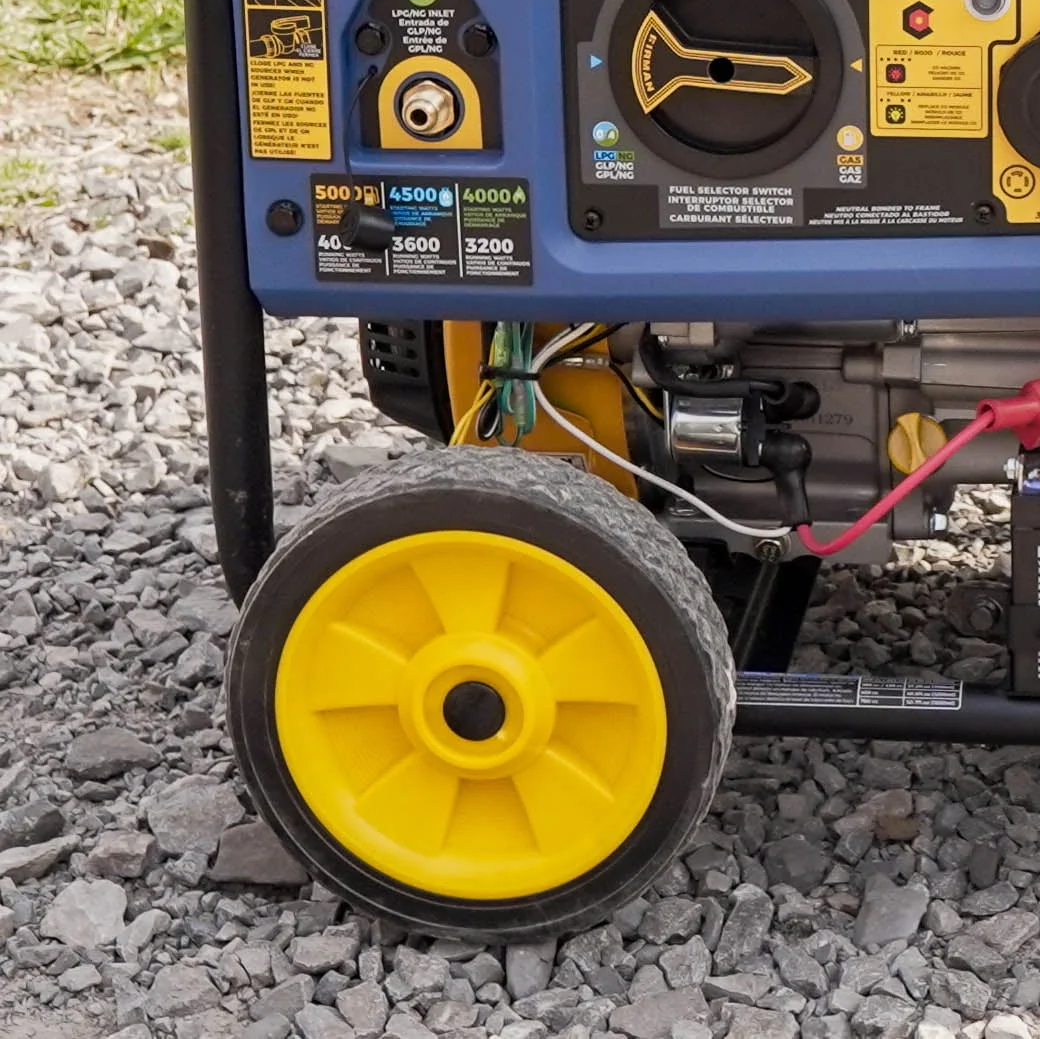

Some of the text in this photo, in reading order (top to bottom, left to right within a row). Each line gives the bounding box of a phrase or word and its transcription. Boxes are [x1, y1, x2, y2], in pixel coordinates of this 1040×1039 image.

[391, 10, 455, 18] LPG/NG INLET
[399, 19, 435, 27] Entrada
[407, 28, 442, 36] GLP/NG
[402, 36, 434, 44] Entrée
[408, 45, 443, 53] GPL/NG
[642, 34, 657, 92] FIRMAN
[619, 152, 634, 160] NG
[595, 162, 634, 171] GLP/NG
[839, 166, 862, 174] GAS
[595, 171, 634, 180] GPL/NG
[839, 175, 862, 183] GAZ
[389, 187, 437, 202] 4500
[669, 186, 792, 196] FUEL SELECTOR SWITCH
[463, 189, 511, 204] 4000
[668, 196, 794, 206] INTERRUPTOR SELECTOR
[687, 204, 776, 213] DE COMBUSTIBLE
[669, 214, 794, 224] CARBURANT SÉLECTEUR
[392, 237, 440, 252] 3600
[465, 238, 514, 254] 3200
